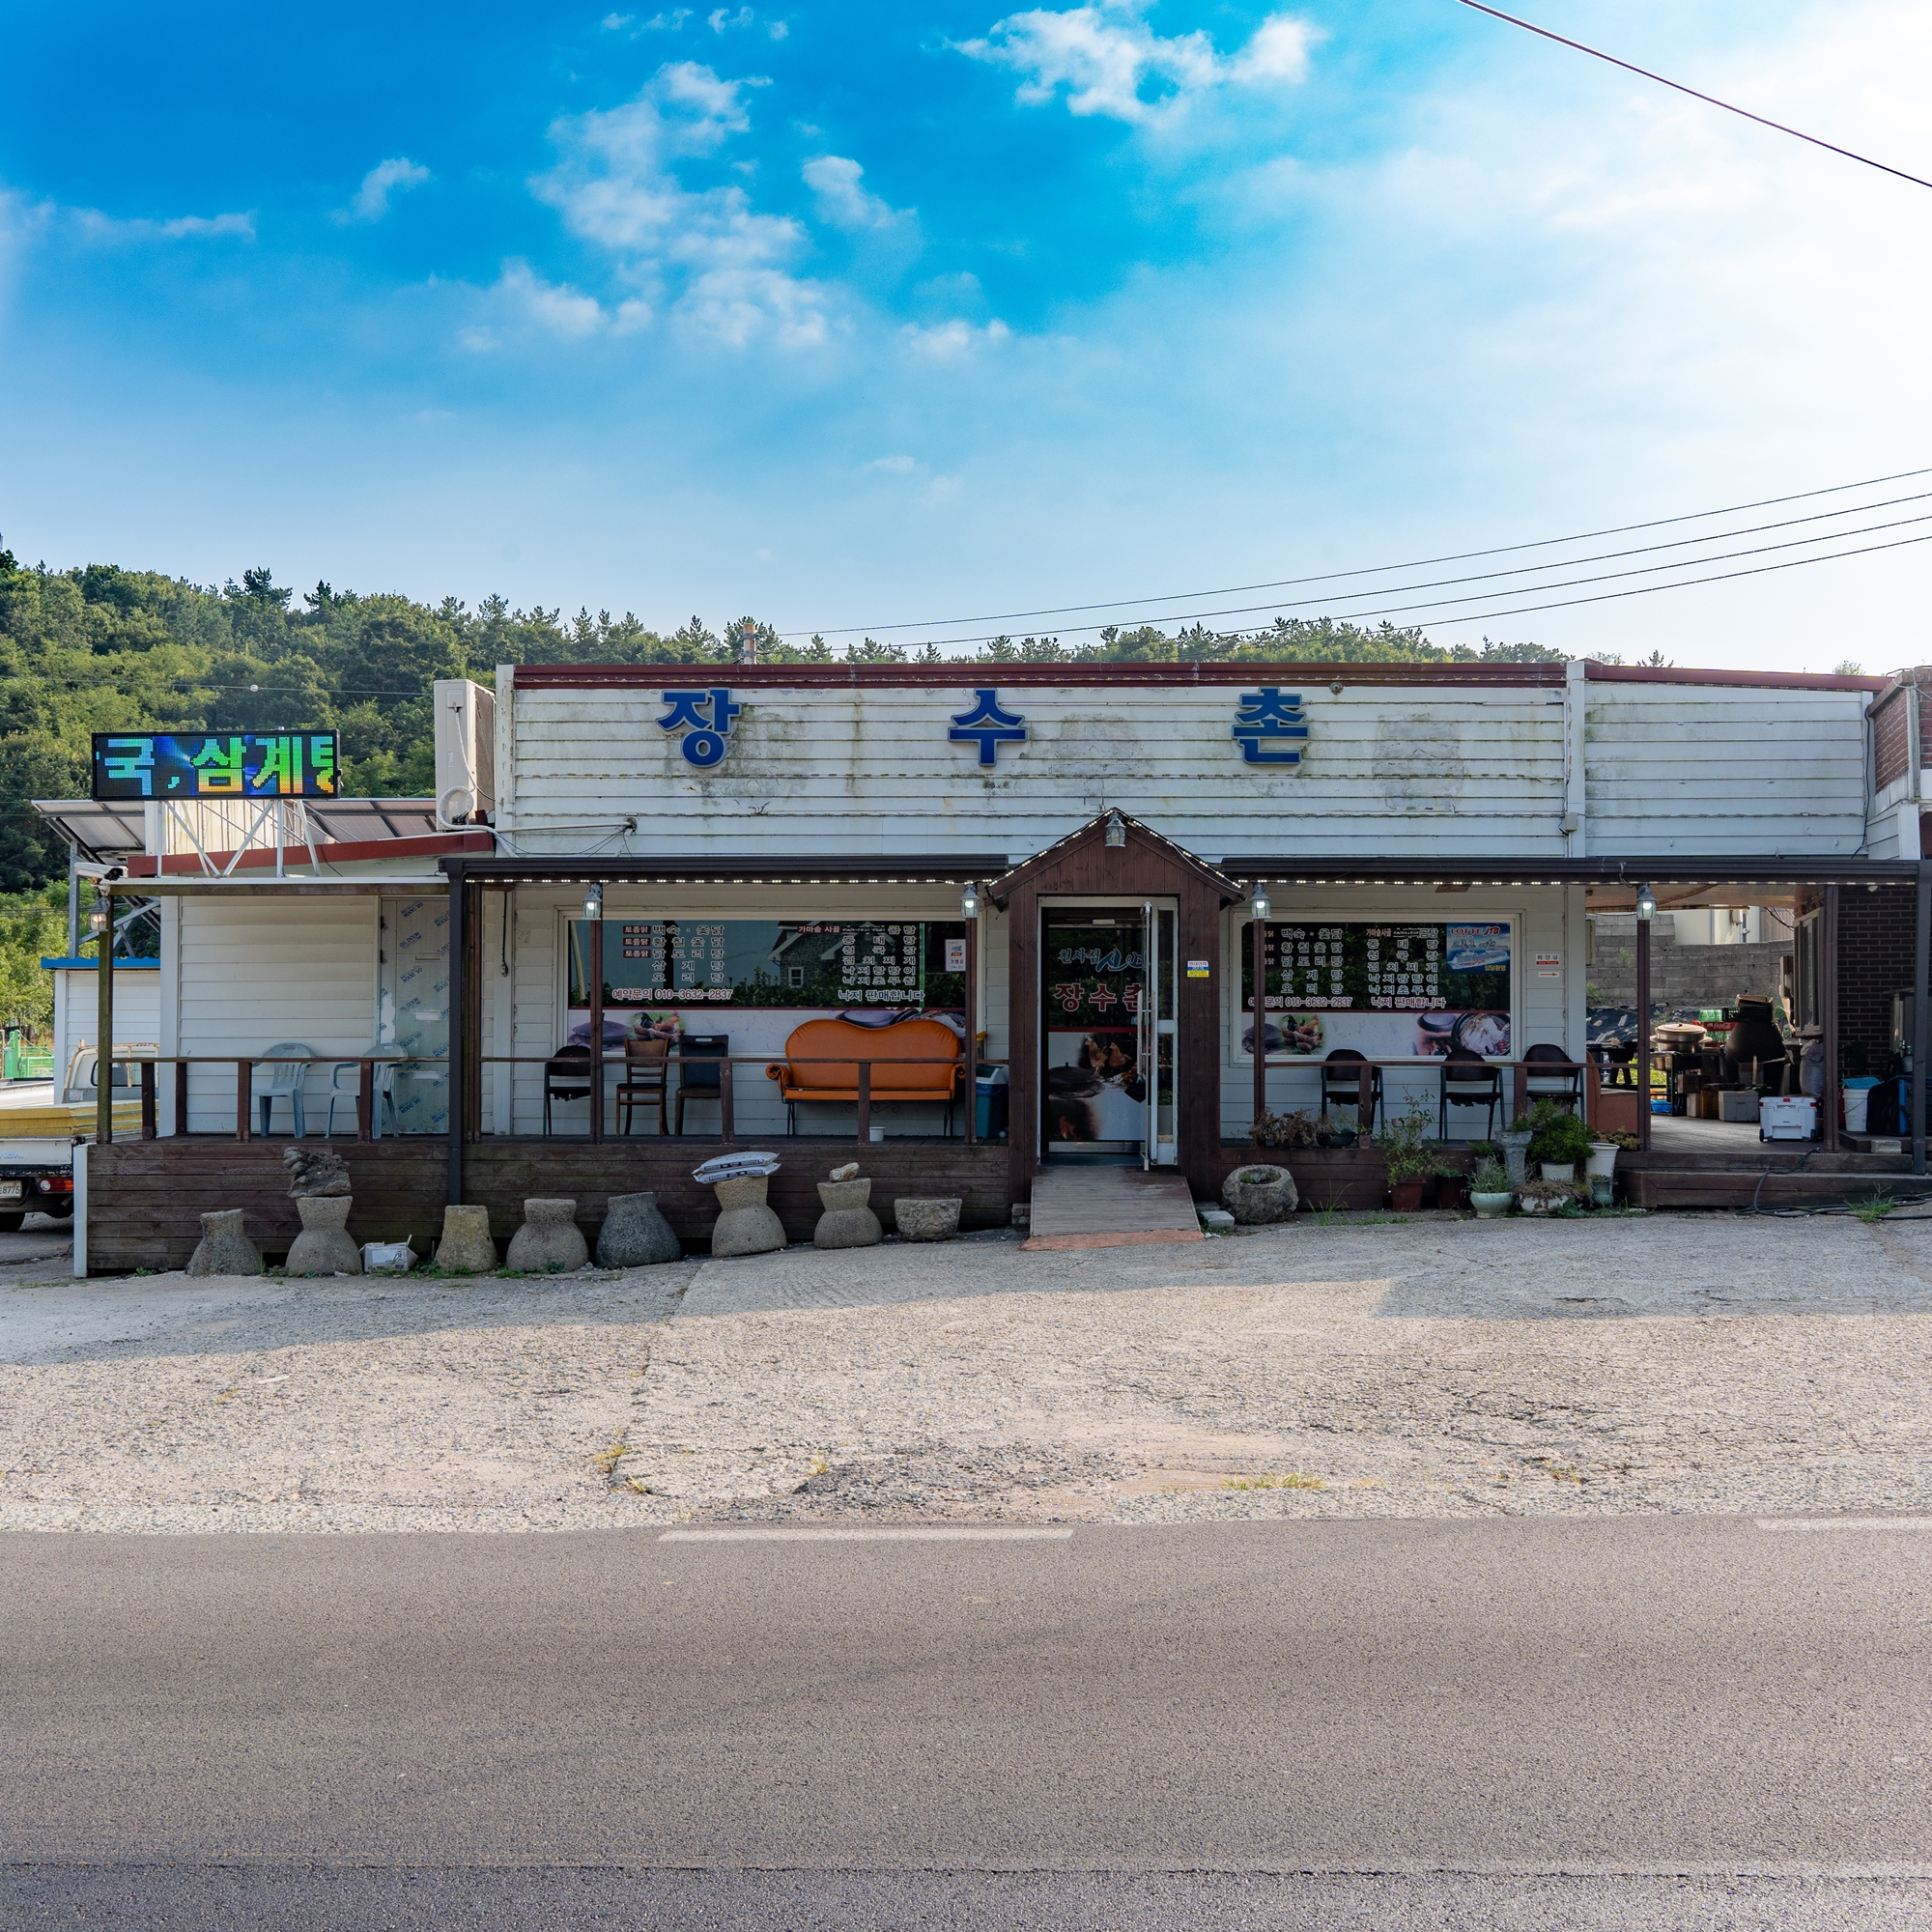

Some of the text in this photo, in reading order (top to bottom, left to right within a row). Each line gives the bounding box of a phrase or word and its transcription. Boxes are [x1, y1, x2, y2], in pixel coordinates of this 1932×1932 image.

[652, 925, 680, 934] 백숙
[1281, 928, 1306, 940] 백숙
[842, 956, 917, 965] 김치찌개
[1058, 948, 1101, 964] 천사섬
[652, 960, 724, 971] 삼계탕
[1367, 961, 1438, 972] 김치찌개
[652, 972, 724, 982] 오리탕
[1281, 969, 1344, 981] 삼계탕
[611, 988, 733, 1001] 예약문의 010-3632-2837
[1281, 982, 1344, 995] 오리탕
[838, 990, 925, 1002] 낙지 판매합니다
[1285, 996, 1353, 1008] 010-3632-2837
[1371, 997, 1446, 1009] 낙지 판매합니다
